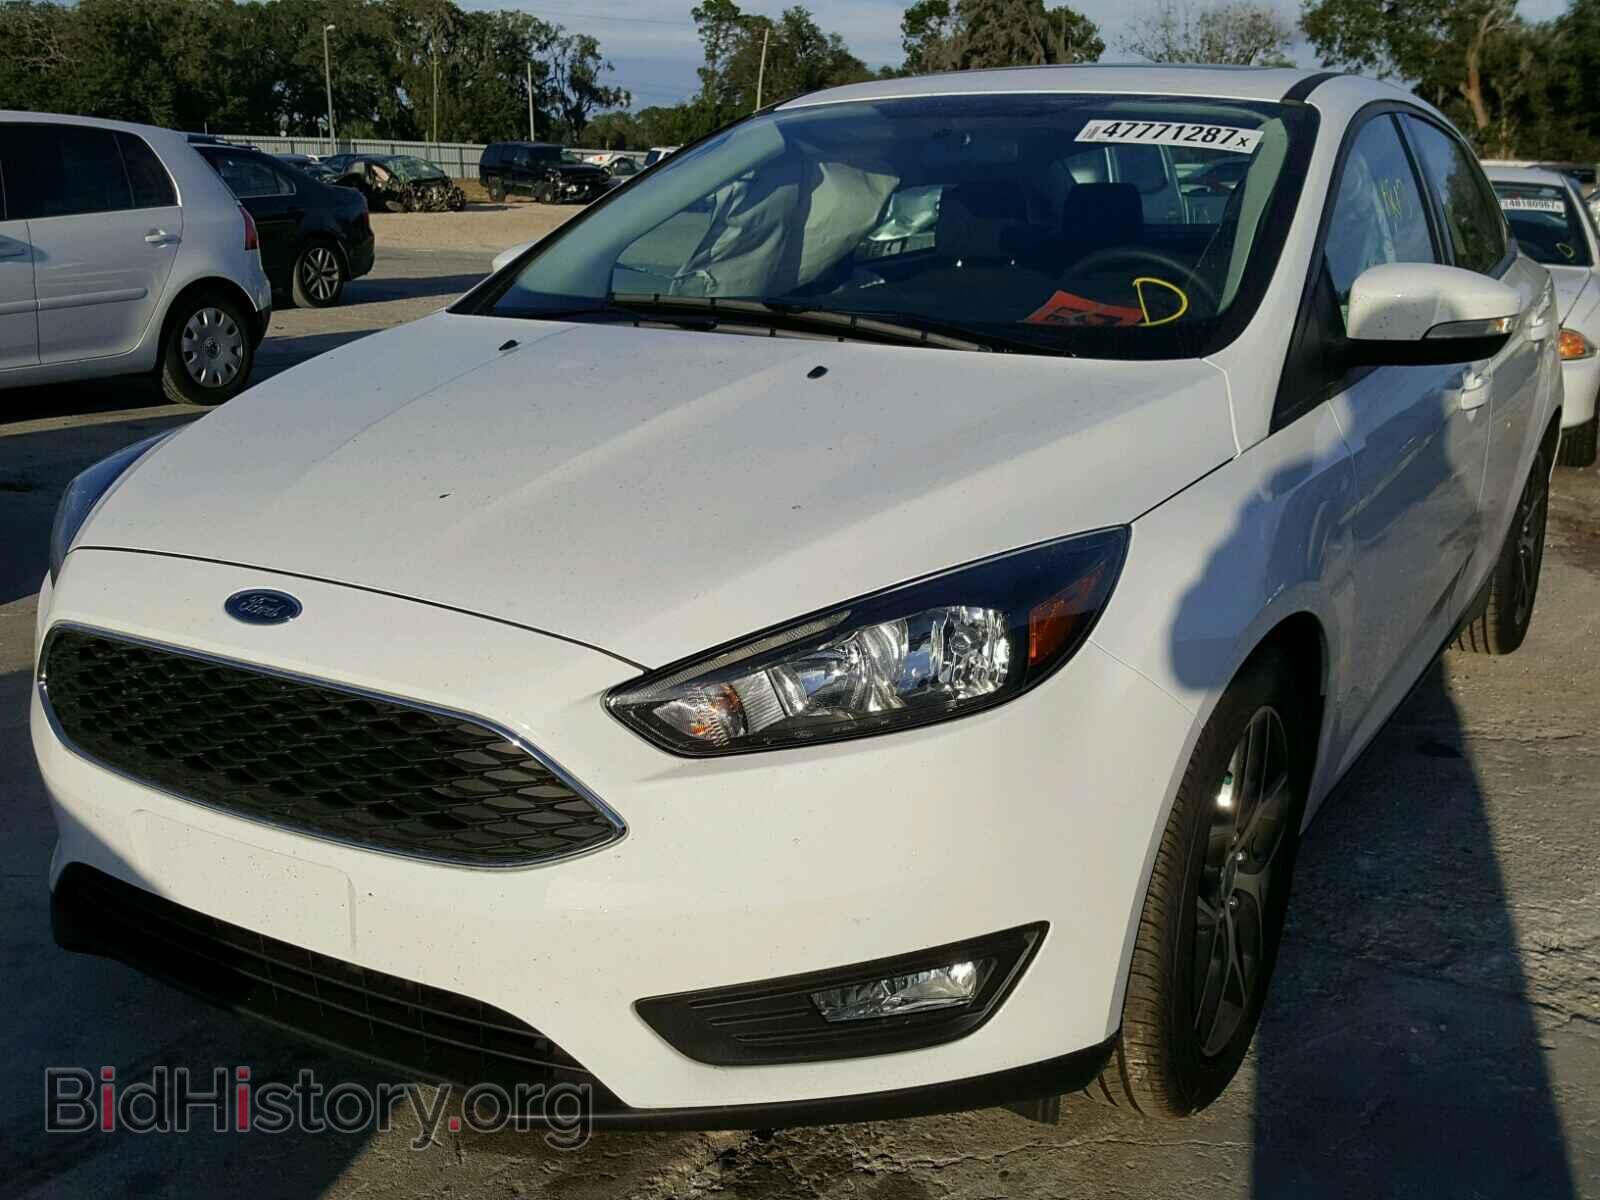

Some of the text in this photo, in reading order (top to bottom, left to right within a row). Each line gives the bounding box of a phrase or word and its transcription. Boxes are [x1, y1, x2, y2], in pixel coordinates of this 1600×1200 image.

[1102, 121, 1239, 145] 47771287
[1132, 277, 1189, 326] D
[239, 594, 288, 618] Ford
